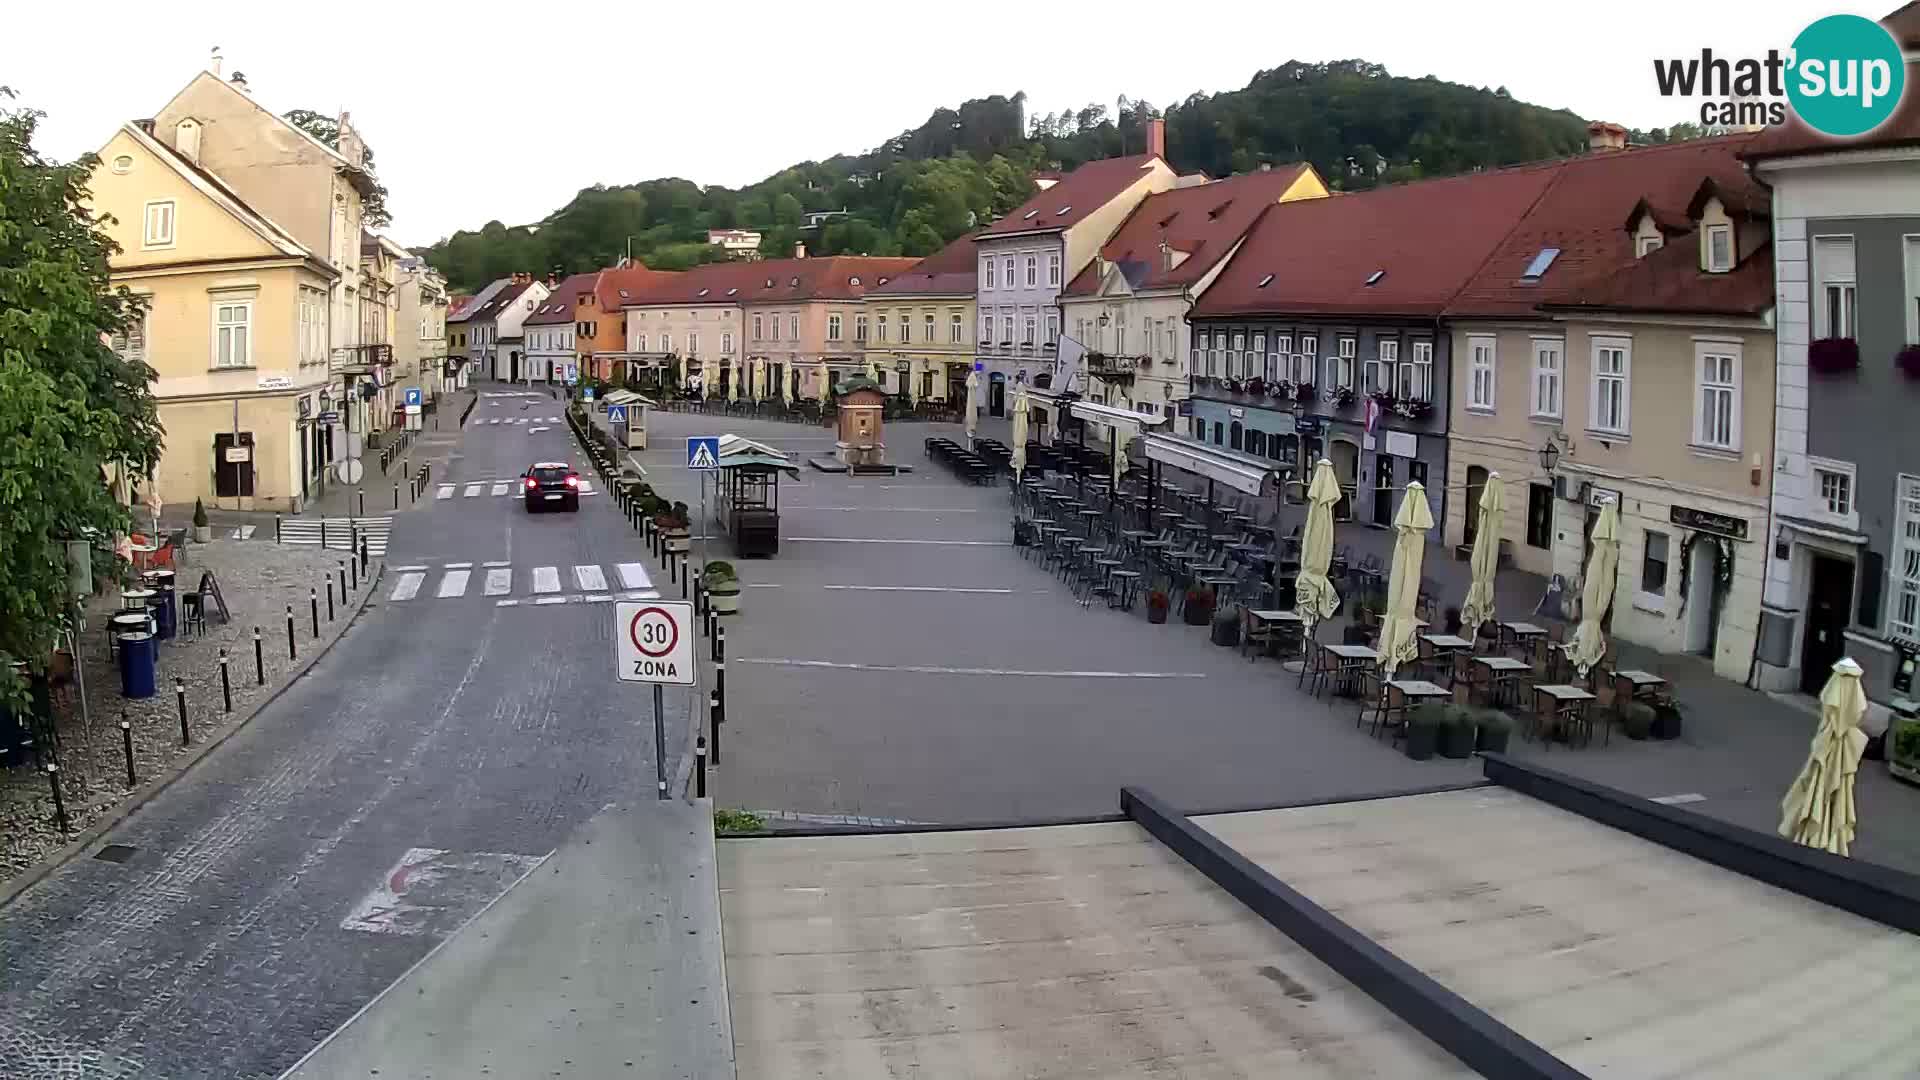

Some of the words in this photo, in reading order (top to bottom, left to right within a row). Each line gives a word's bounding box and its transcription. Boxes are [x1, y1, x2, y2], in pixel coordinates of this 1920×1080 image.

[409, 391, 417, 403] P
[643, 623, 667, 644] 30
[633, 660, 678, 677] ZONA
